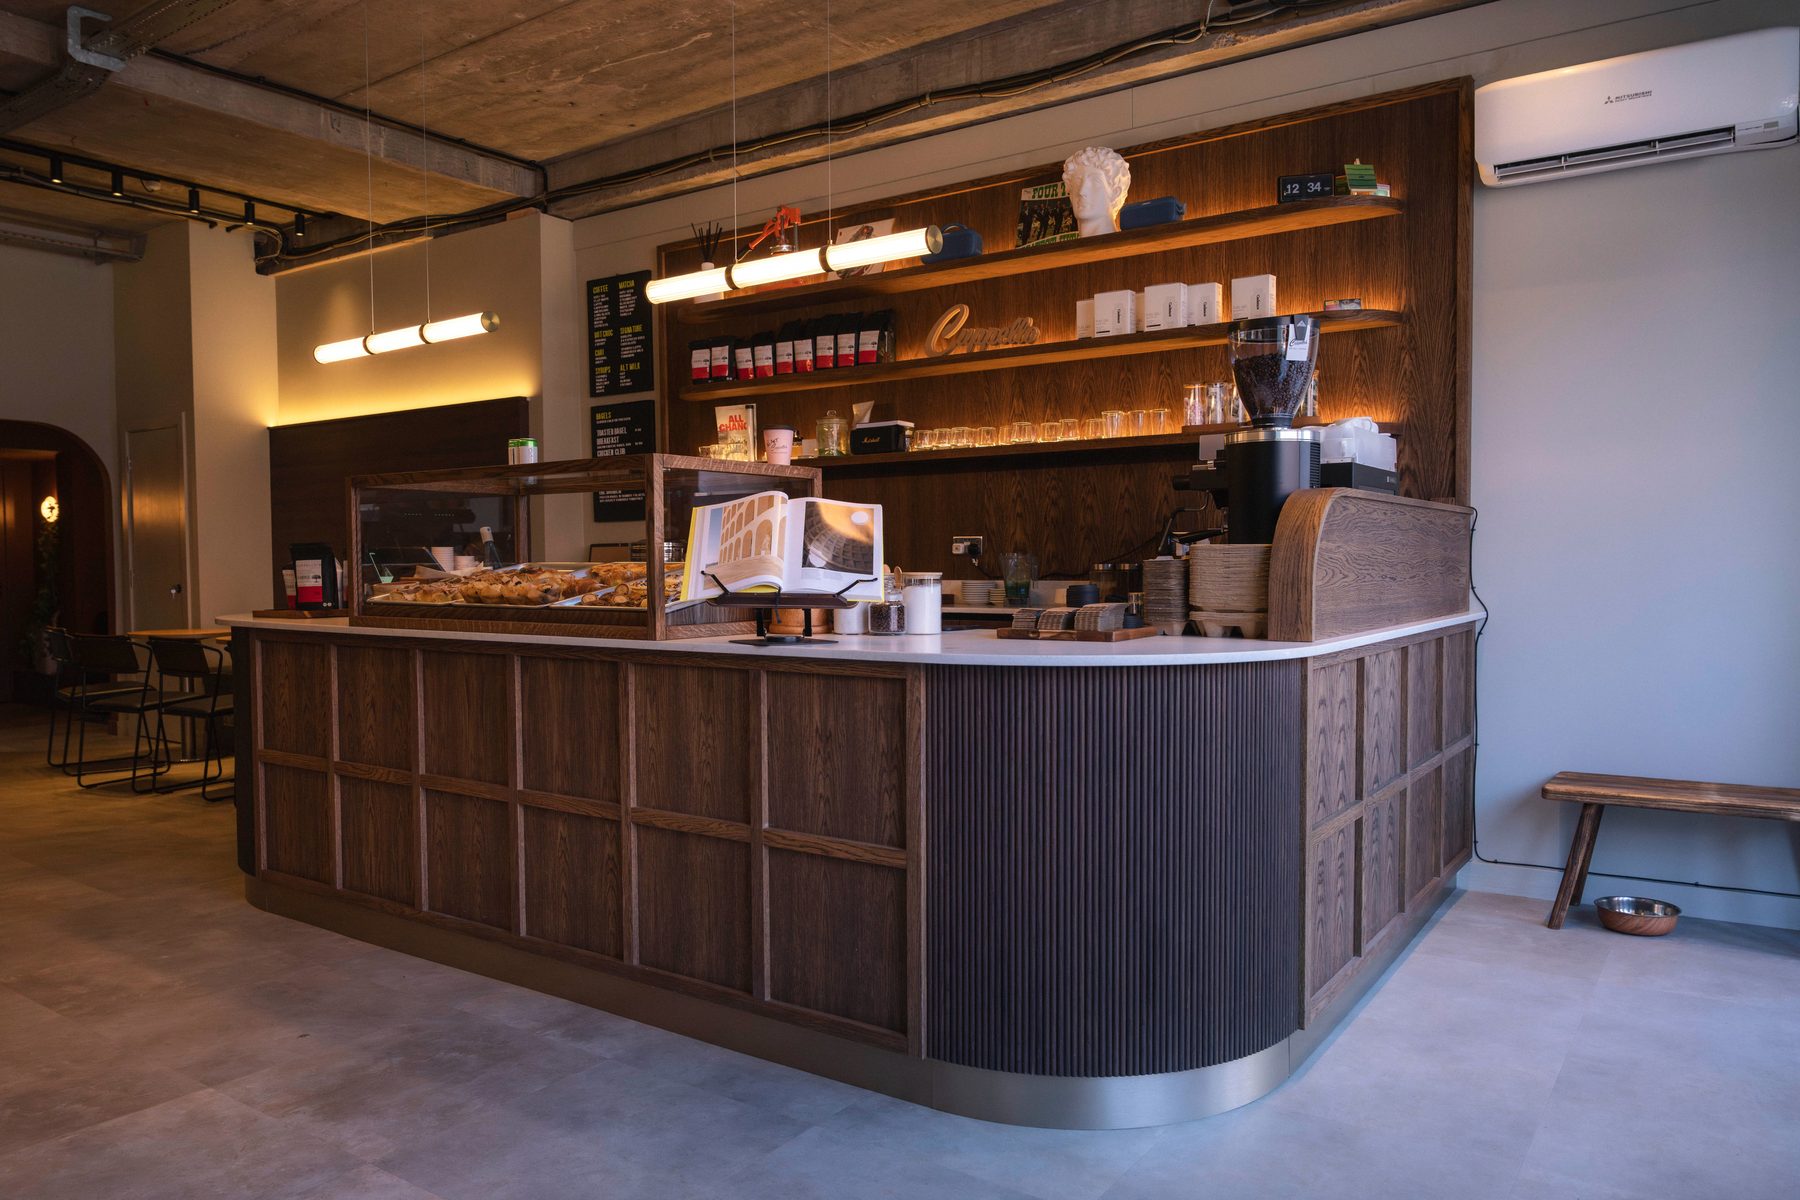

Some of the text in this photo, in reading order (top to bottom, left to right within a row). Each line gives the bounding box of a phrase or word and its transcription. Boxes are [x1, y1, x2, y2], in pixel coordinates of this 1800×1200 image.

[1031, 183, 1059, 199] FOUR
[1286, 181, 1322, 194] 12 34
[593, 284, 609, 294] COFFEE
[619, 280, 635, 289] MATCHA
[620, 324, 642, 334] SIGNATURE
[595, 366, 611, 375] SYRUPS
[596, 412, 612, 420] BAGELS
[728, 414, 744, 423] ALL
[614, 427, 627, 435] BAGEL
[596, 436, 620, 445] BREAKFAST
[597, 447, 626, 457] CHICKEN CLUB
